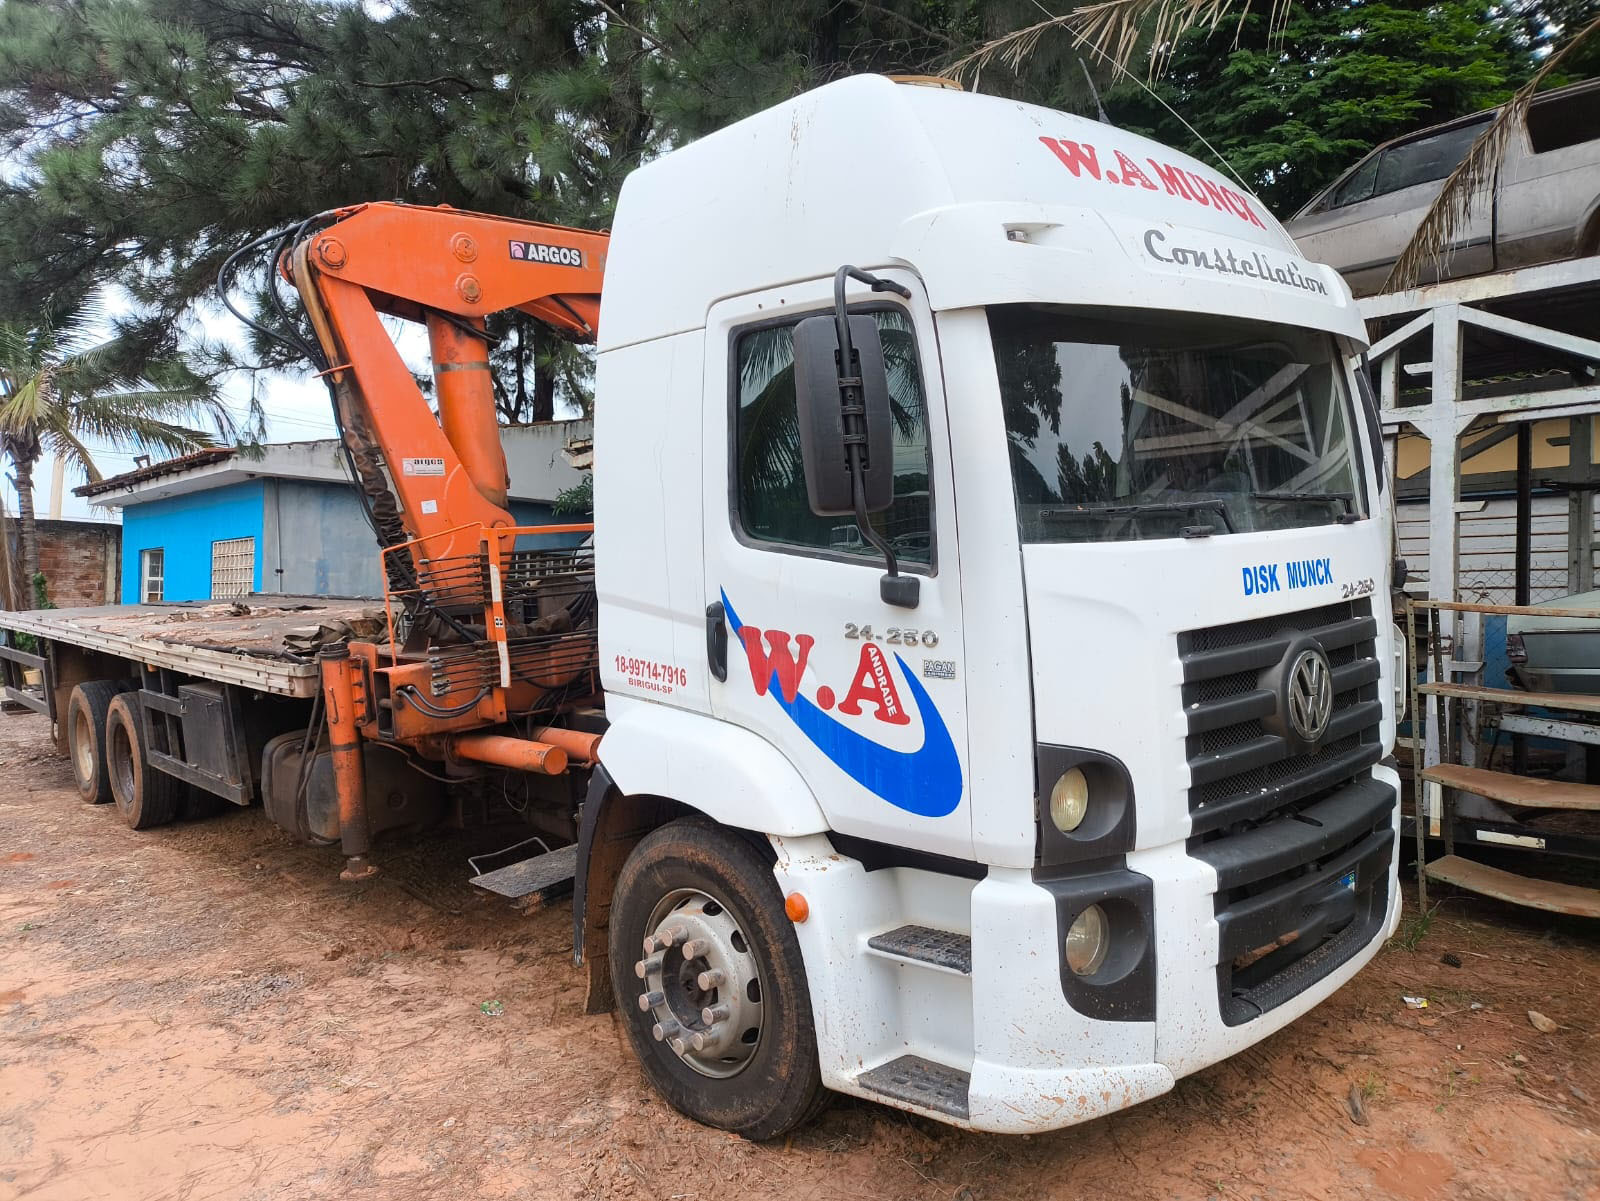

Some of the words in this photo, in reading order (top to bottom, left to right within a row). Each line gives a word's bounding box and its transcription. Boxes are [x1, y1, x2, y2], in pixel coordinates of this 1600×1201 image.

[1146, 158, 1267, 231] MUNCK
[527, 243, 581, 266] ARGOS
[1144, 229, 1328, 296] Constellation
[1242, 563, 1281, 596] DISK
[1286, 558, 1334, 590] MUNCK
[1341, 577, 1375, 599] 24-250
[844, 622, 939, 649] 24-250
[615, 654, 687, 687] 18-99714-7916
[923, 659, 956, 673] PAGAN
[628, 677, 673, 695] BIRIGUI-SP
[867, 646, 898, 718] ANDRADE
